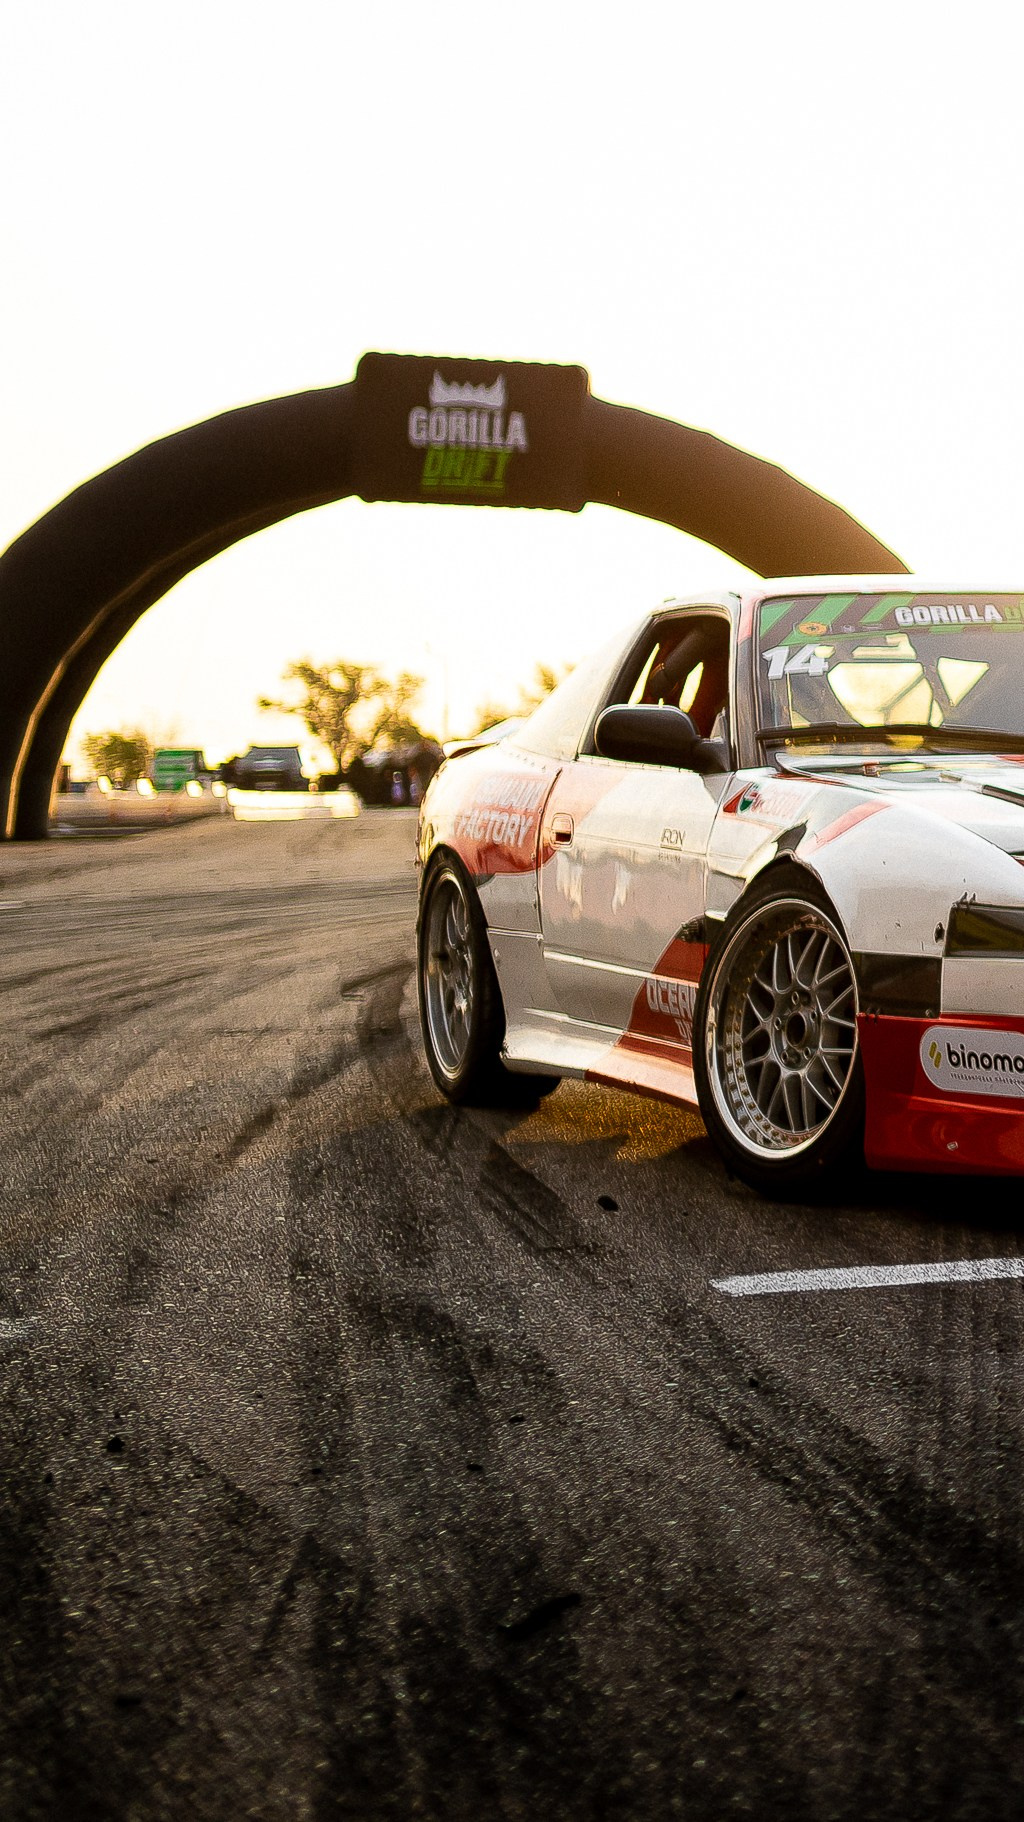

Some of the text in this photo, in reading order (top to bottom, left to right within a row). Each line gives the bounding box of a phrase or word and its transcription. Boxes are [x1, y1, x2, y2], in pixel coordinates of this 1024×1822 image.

[409, 407, 527, 451] GORILLA
[421, 447, 513, 486] DRIFT
[894, 604, 1003, 627] GORILLA
[761, 643, 829, 680] 14
[457, 809, 533, 847] FACTORY
